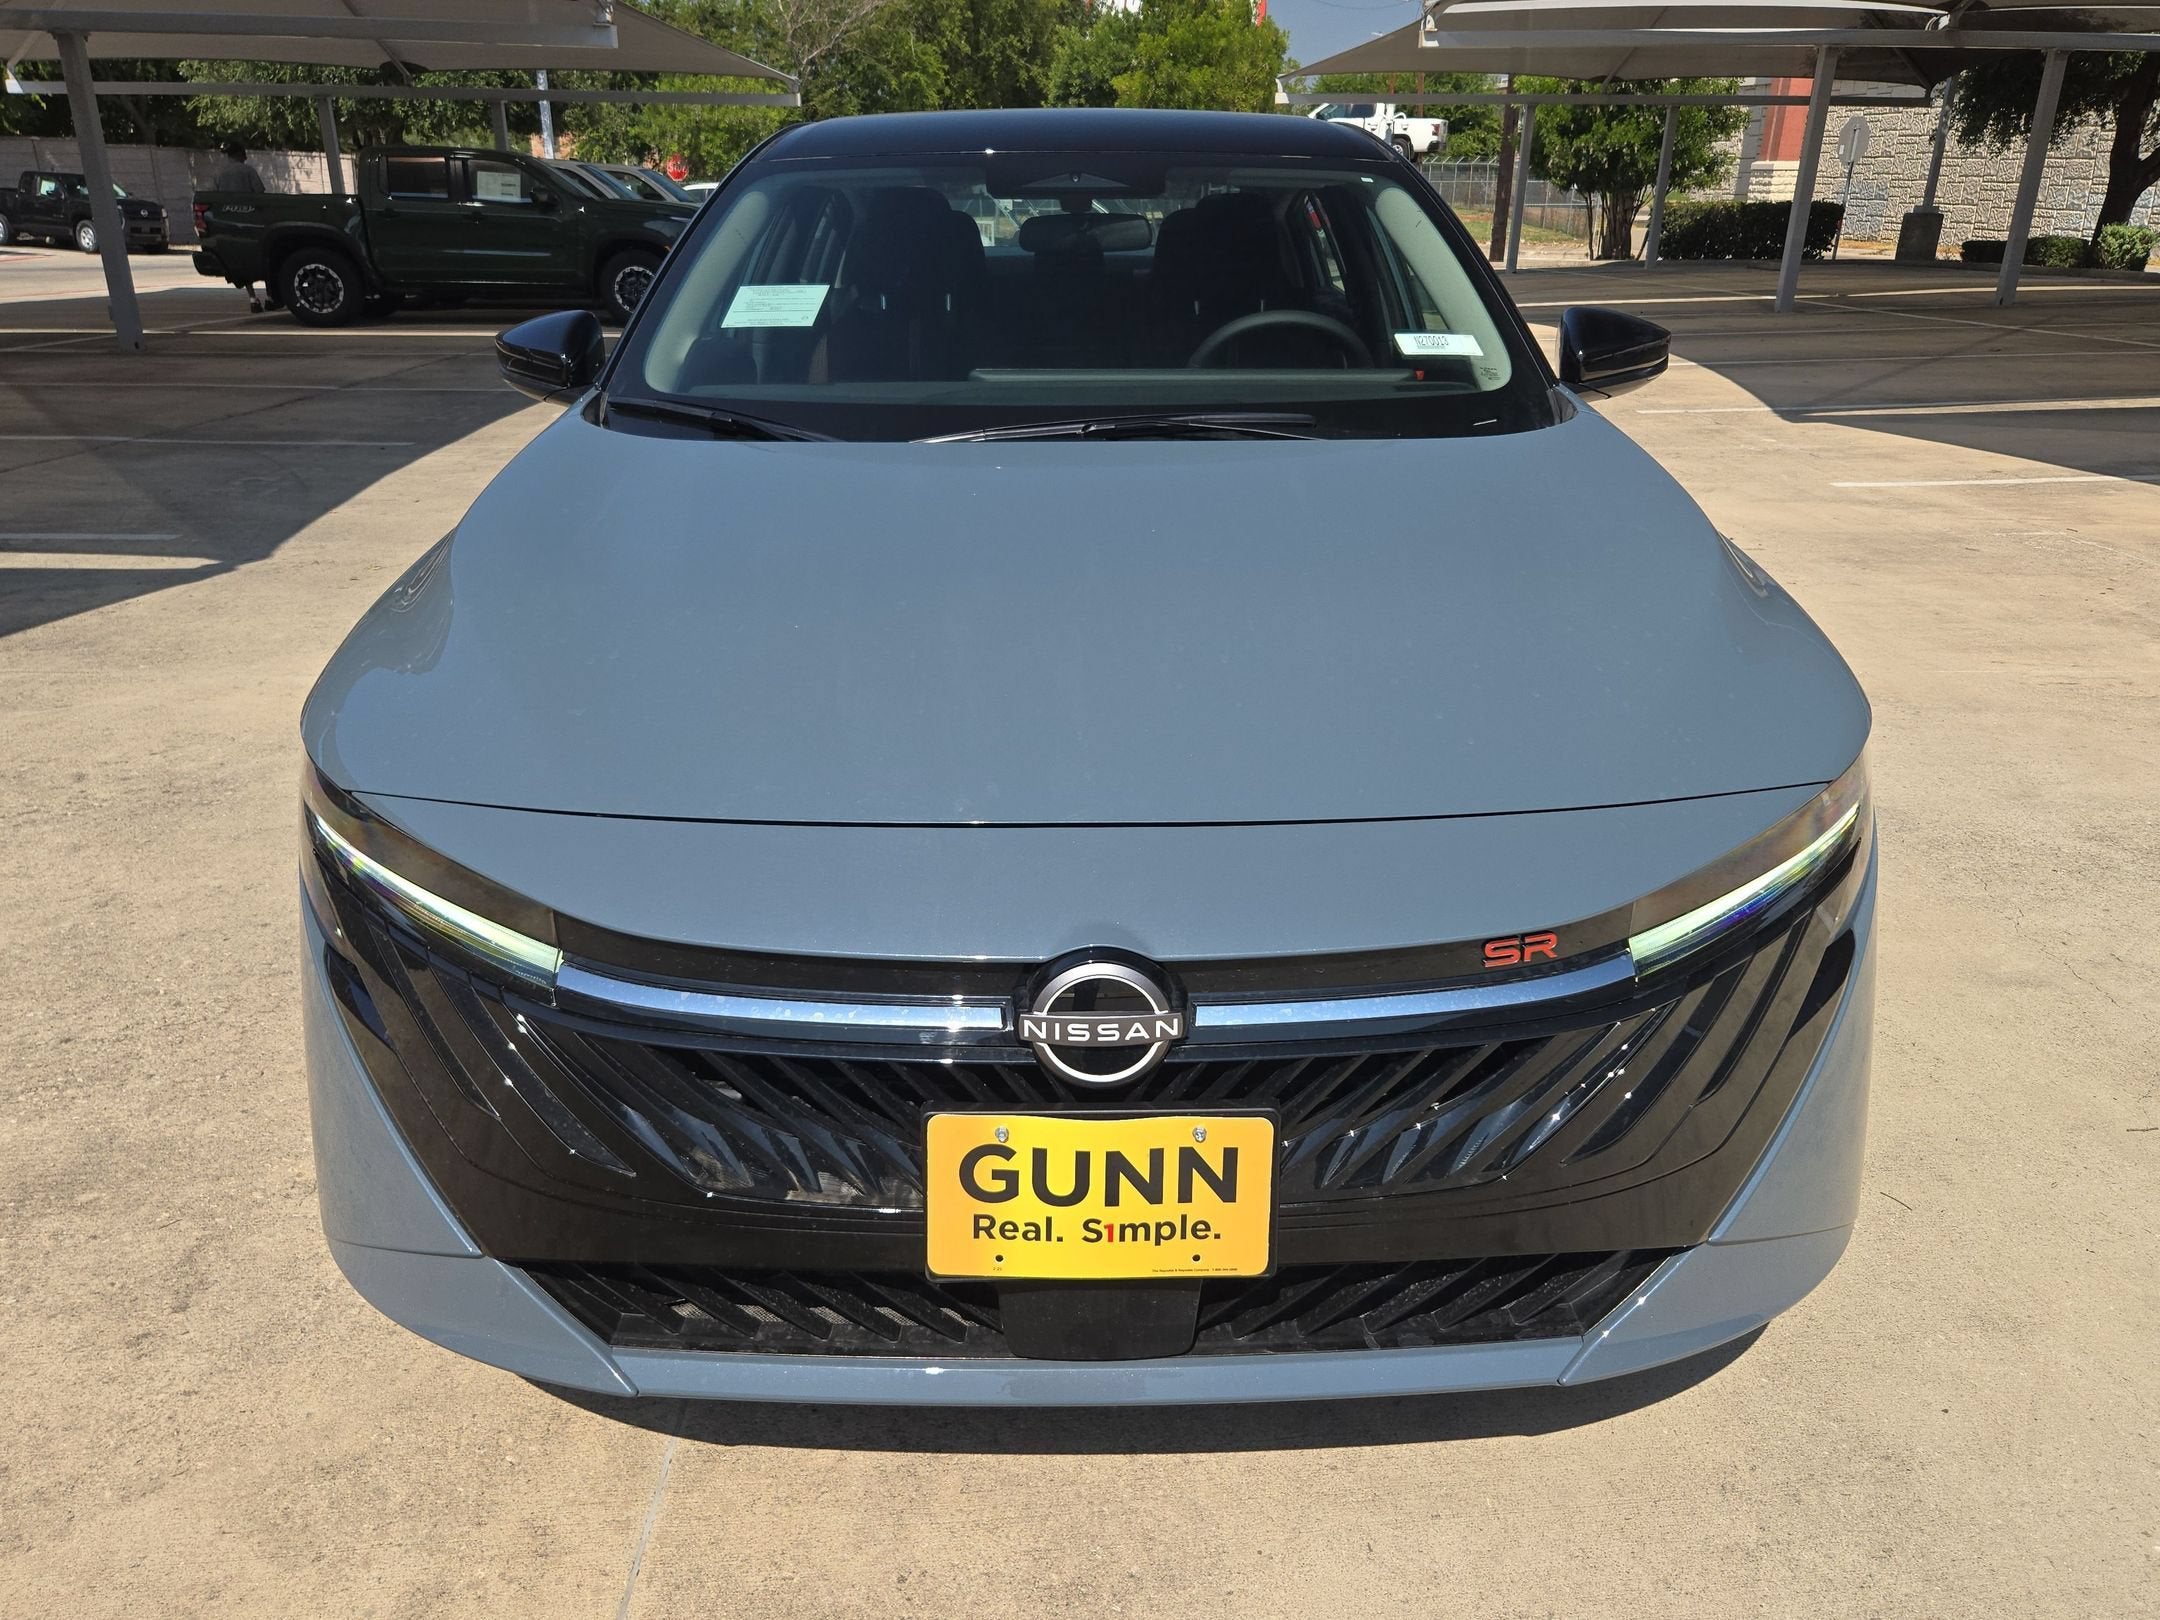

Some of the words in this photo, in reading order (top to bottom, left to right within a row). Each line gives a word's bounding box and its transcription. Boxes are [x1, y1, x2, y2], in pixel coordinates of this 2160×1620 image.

[1483, 932, 1558, 968] SR
[1023, 1018, 1179, 1042] NISSAN
[959, 1143, 1239, 1207] GUNN
[973, 1213, 1064, 1243] Real.
